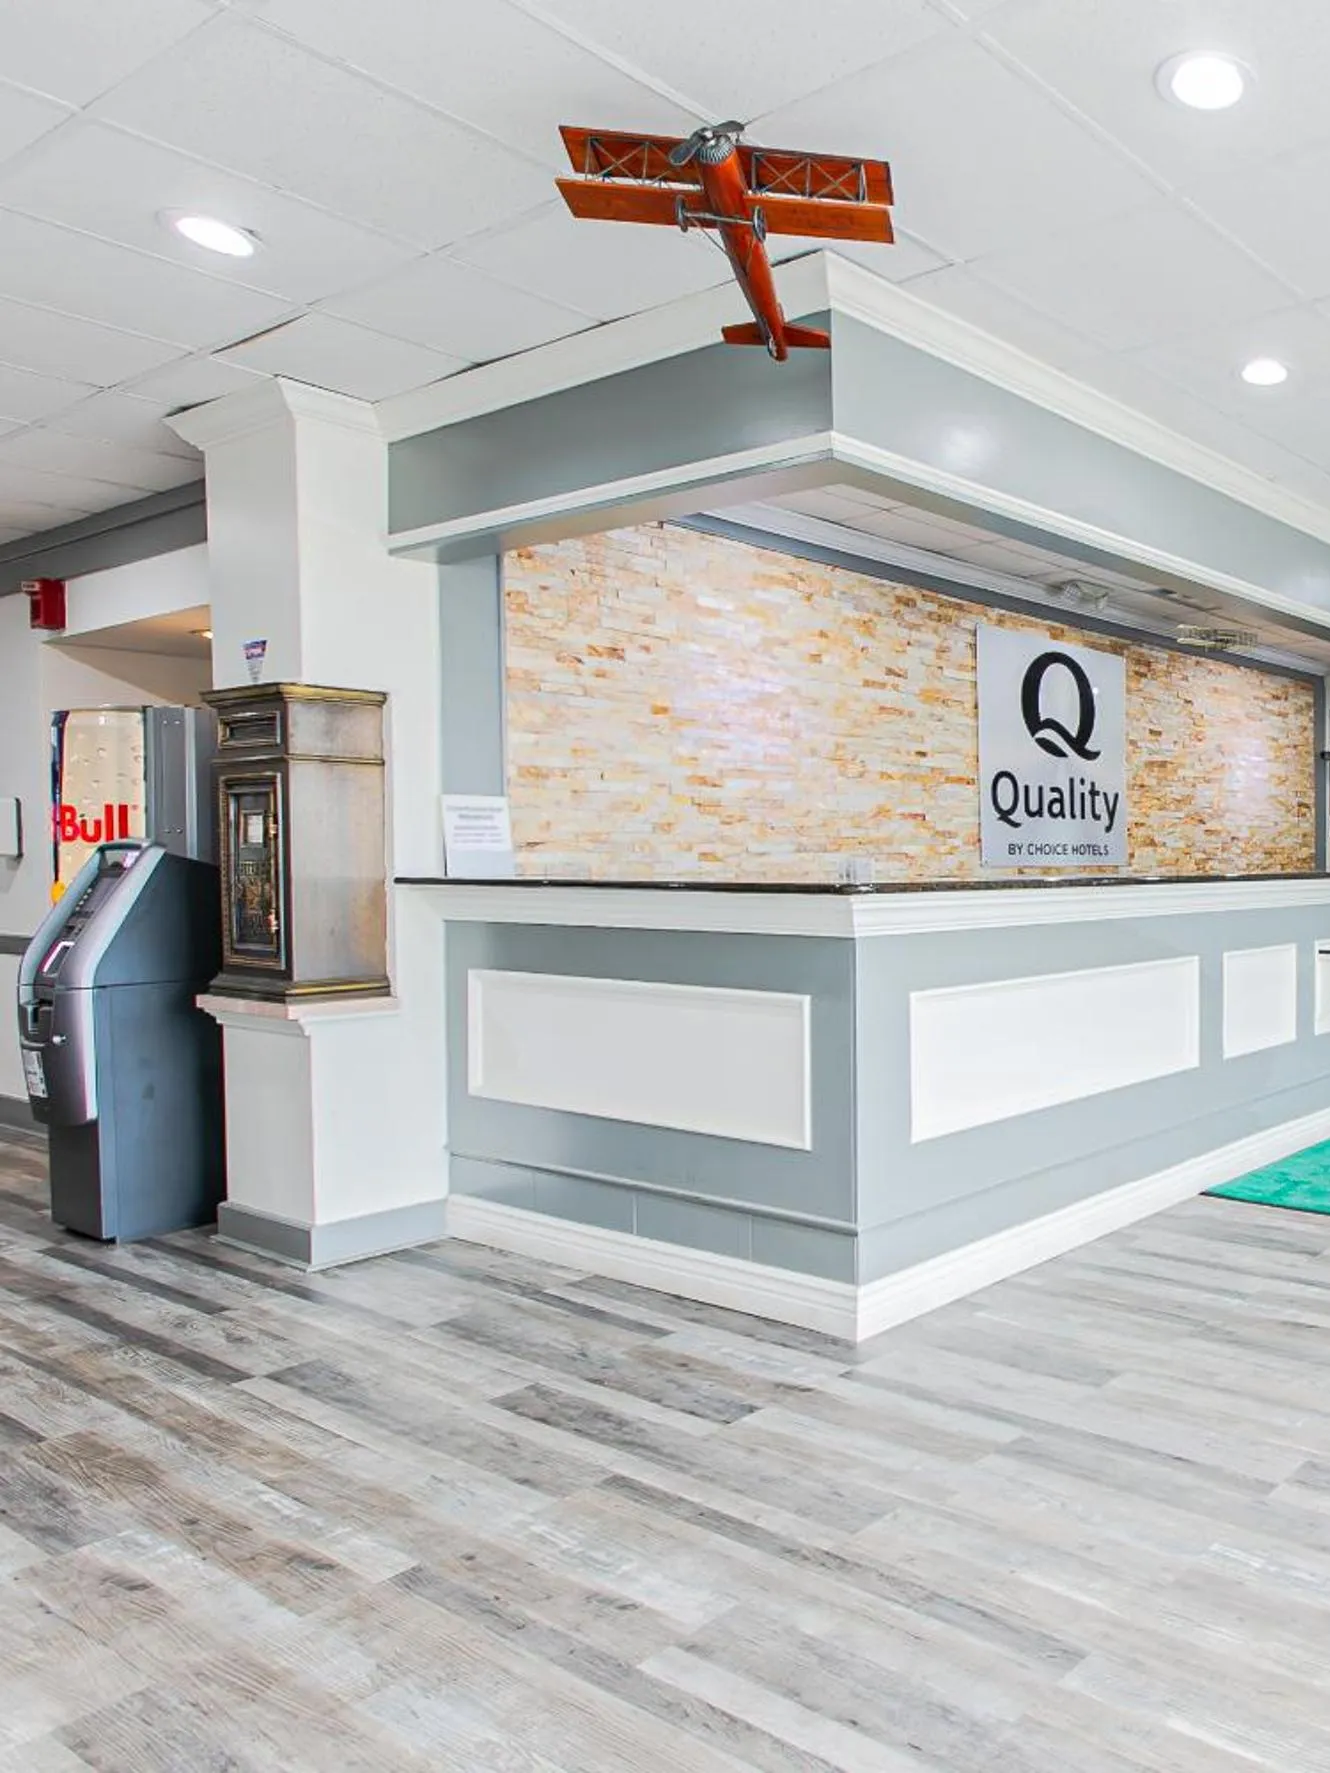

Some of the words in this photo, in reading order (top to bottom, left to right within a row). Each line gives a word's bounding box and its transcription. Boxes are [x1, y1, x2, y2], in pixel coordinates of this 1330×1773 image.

[1021, 651, 1101, 761] Q
[60, 804, 129, 842] Bull
[991, 770, 1119, 833] Quality
[1008, 843, 1023, 856] BY
[1027, 843, 1068, 856] CHOICE
[1072, 843, 1109, 857] HOTELS
